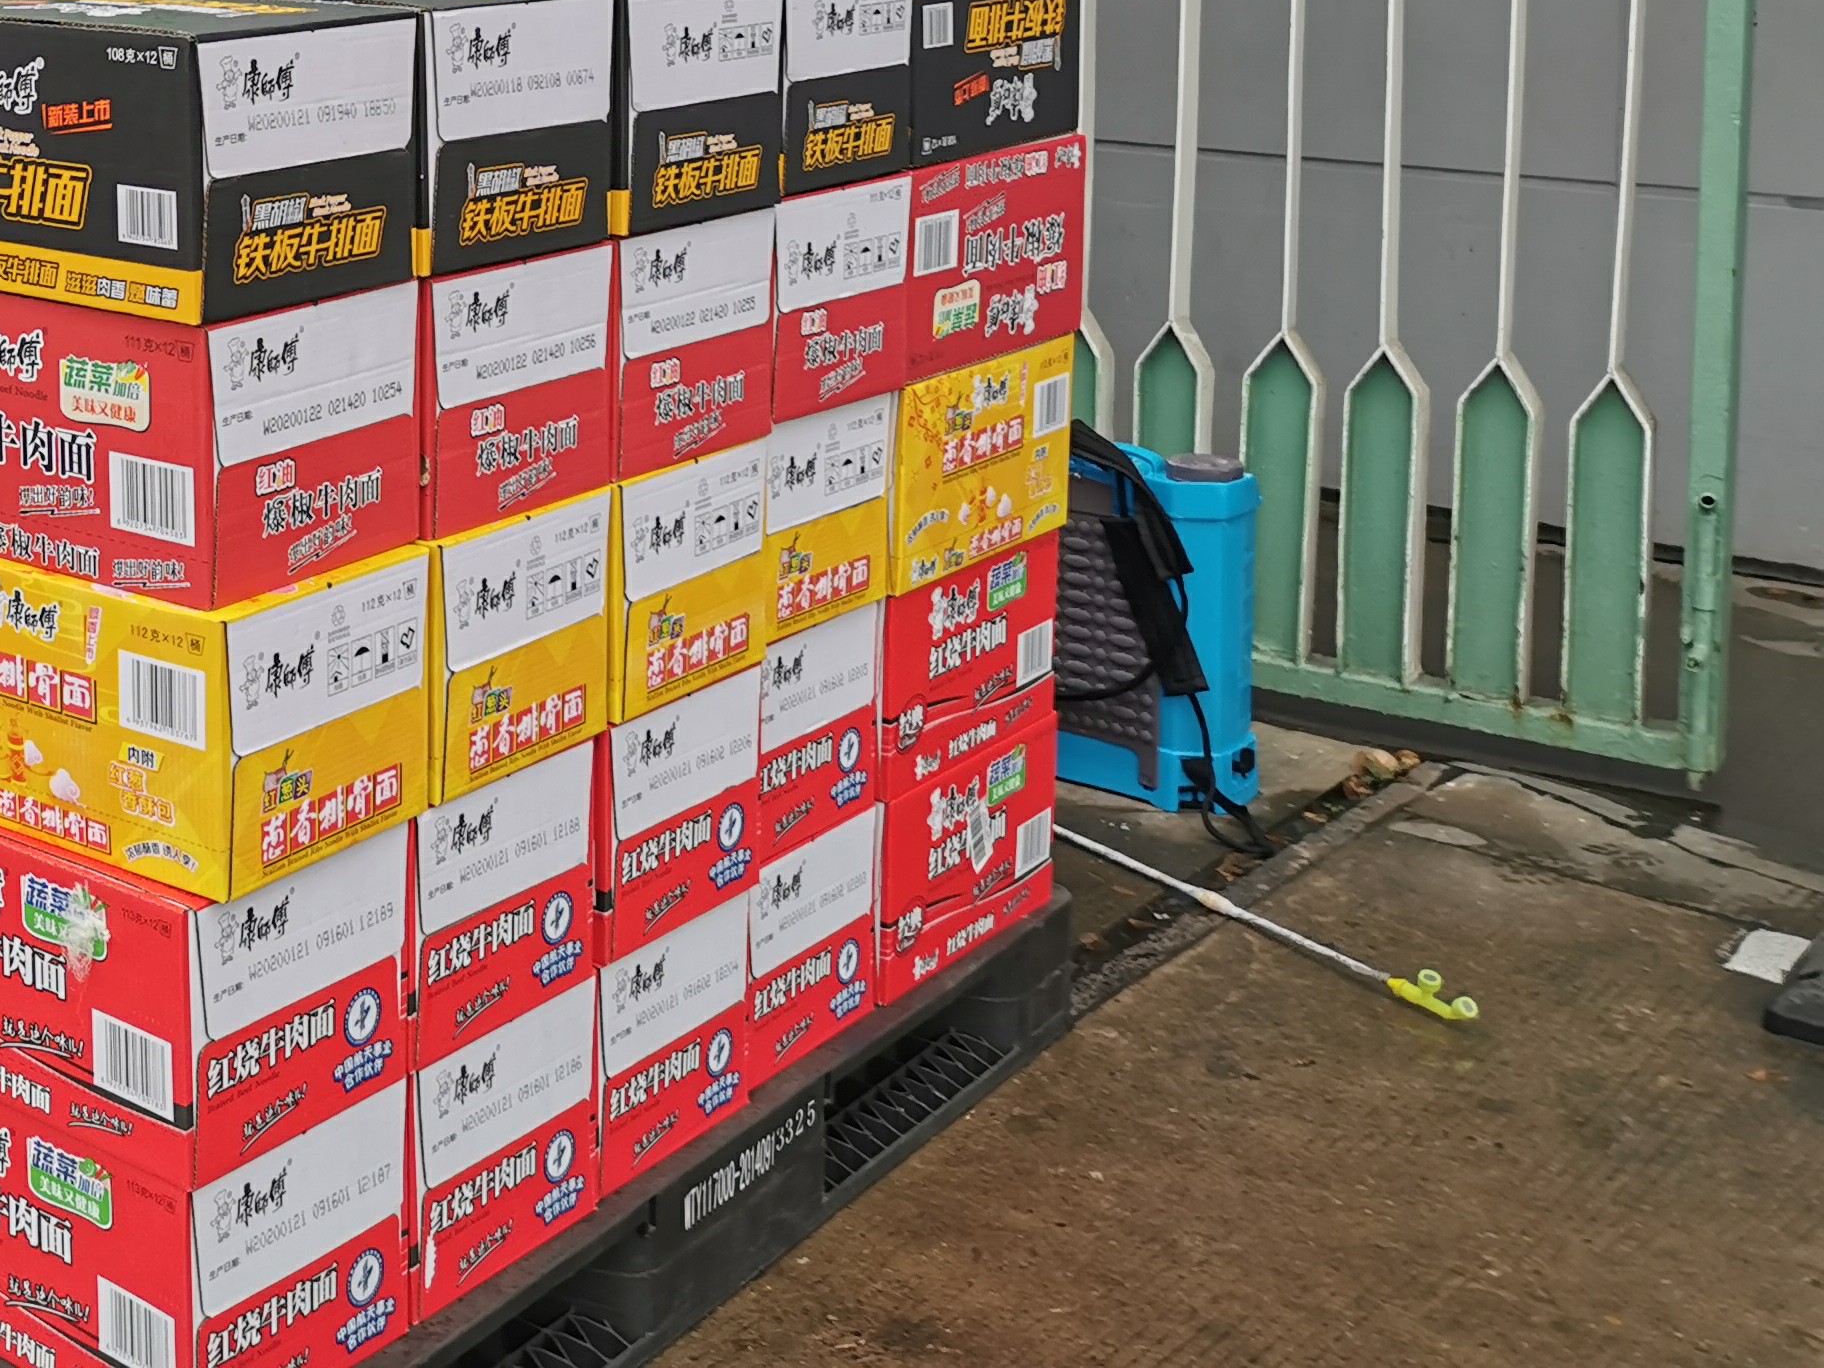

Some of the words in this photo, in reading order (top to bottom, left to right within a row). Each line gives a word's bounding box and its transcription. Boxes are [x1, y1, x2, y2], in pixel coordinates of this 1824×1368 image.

[467, 27, 511, 70] 康師傅
[242, 59, 295, 105] 康師傅
[42, 99, 112, 130] 新装上市
[804, 115, 894, 169] 铁板牛排面
[476, 166, 523, 197] 黑胡椒
[653, 147, 761, 206] 铁板牛排面
[252, 196, 307, 231] 黑胡椒
[461, 180, 586, 243] 铁板牛排面
[236, 209, 384, 280] 铁板牛排面
[961, 211, 1065, 276] 爆椒牛肉面
[466, 291, 510, 333] 康師傅
[248, 337, 299, 382] 康師傅
[476, 352, 527, 381] W20200122
[804, 322, 884, 370] 爆椒牛肉面
[15, 385, 49, 402] Noodle
[63, 355, 143, 401] 蔬菜加倍
[654, 370, 745, 426] 爆椒牛肉面
[72, 395, 136, 423] 美味又健康
[263, 404, 323, 436] W20200122
[328, 391, 366, 417] 021420
[372, 381, 402, 404] 10254
[471, 403, 506, 438] 红油
[476, 414, 579, 476] 爆椒牛肉面
[255, 458, 296, 496] 红油
[262, 467, 382, 539] 爆椒牛肉面
[7, 588, 60, 642] 康師傅
[777, 555, 870, 622] 葱香排骨面
[265, 644, 315, 699] 康師傅
[647, 613, 750, 692] 葱香排骨面
[928, 612, 1007, 680] 红烧牛肉面
[469, 683, 586, 773] 葱香排骨面
[127, 746, 156, 769] 内附
[261, 763, 402, 869] 葱香排骨面
[621, 809, 713, 885] 红烧牛肉面
[239, 896, 290, 952] 康師傅
[427, 900, 535, 985] 红烧牛肉面
[754, 946, 832, 1021] 红烧牛肉面
[207, 999, 336, 1099] 红烧牛肉面
[609, 1038, 701, 1123] 红烧牛肉面
[236, 1167, 287, 1227] 康師傅
[429, 1141, 537, 1233] 红烧牛肉面
[207, 1262, 338, 1368] 红烧牛肉面
